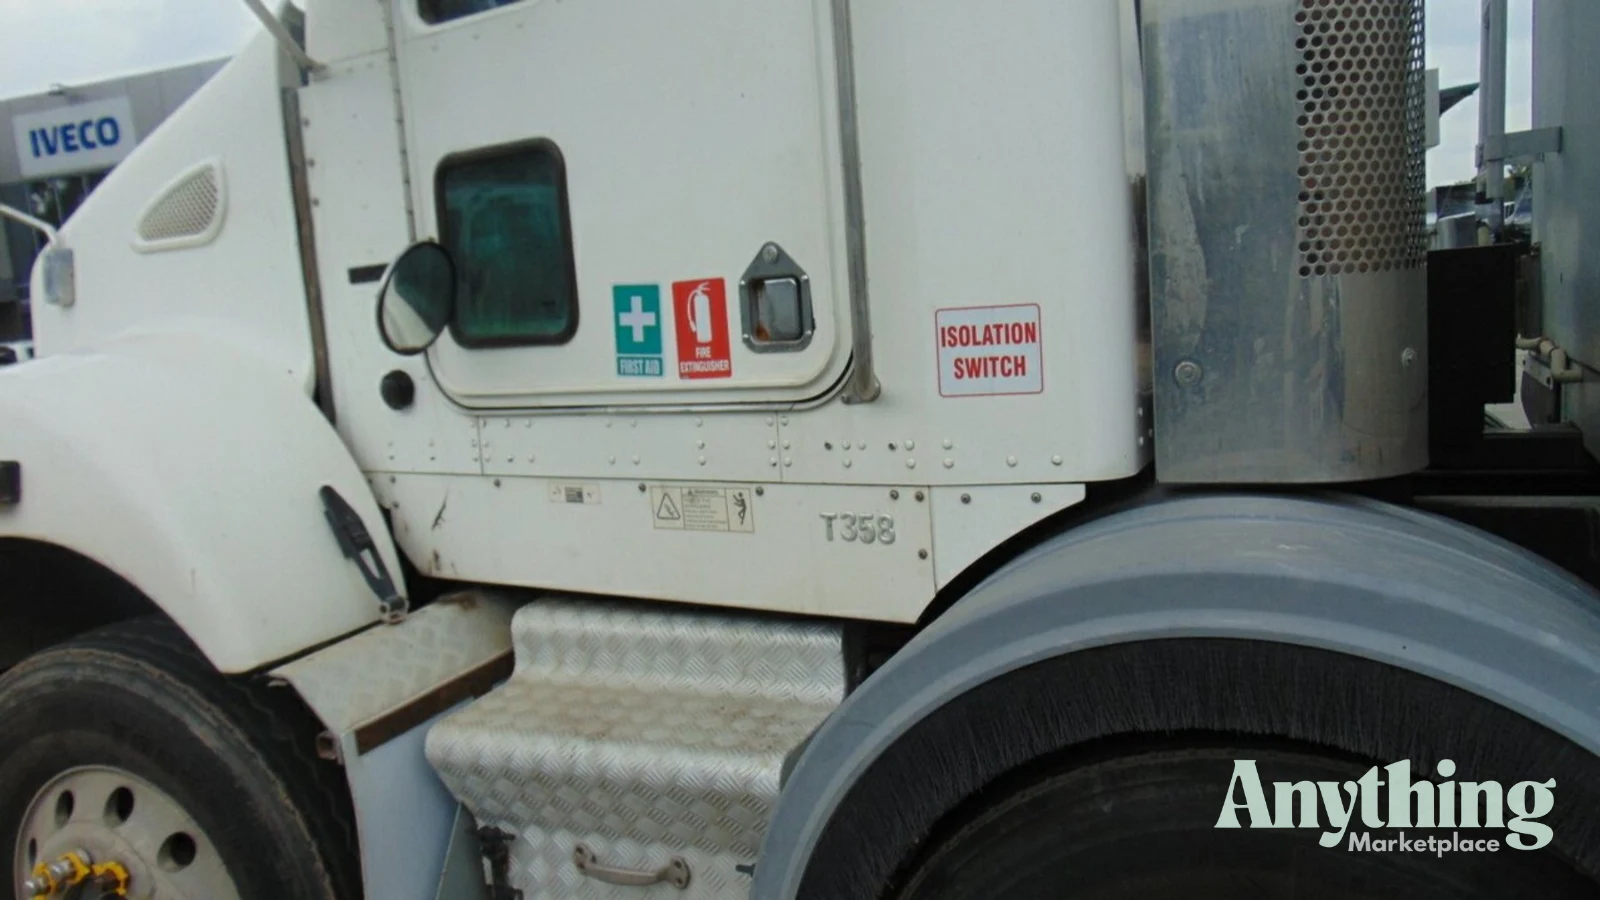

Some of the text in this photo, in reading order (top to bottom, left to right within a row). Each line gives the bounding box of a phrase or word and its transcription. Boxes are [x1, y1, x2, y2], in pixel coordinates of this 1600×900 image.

[29, 116, 120, 158] IVECO
[941, 322, 1036, 347] ISOLATION
[695, 346, 711, 358] FIRE
[620, 359, 660, 375] FIRST AID
[680, 360, 729, 373] EXTINGUISHER
[954, 355, 1026, 379] SWITCH
[819, 511, 896, 545] T358
